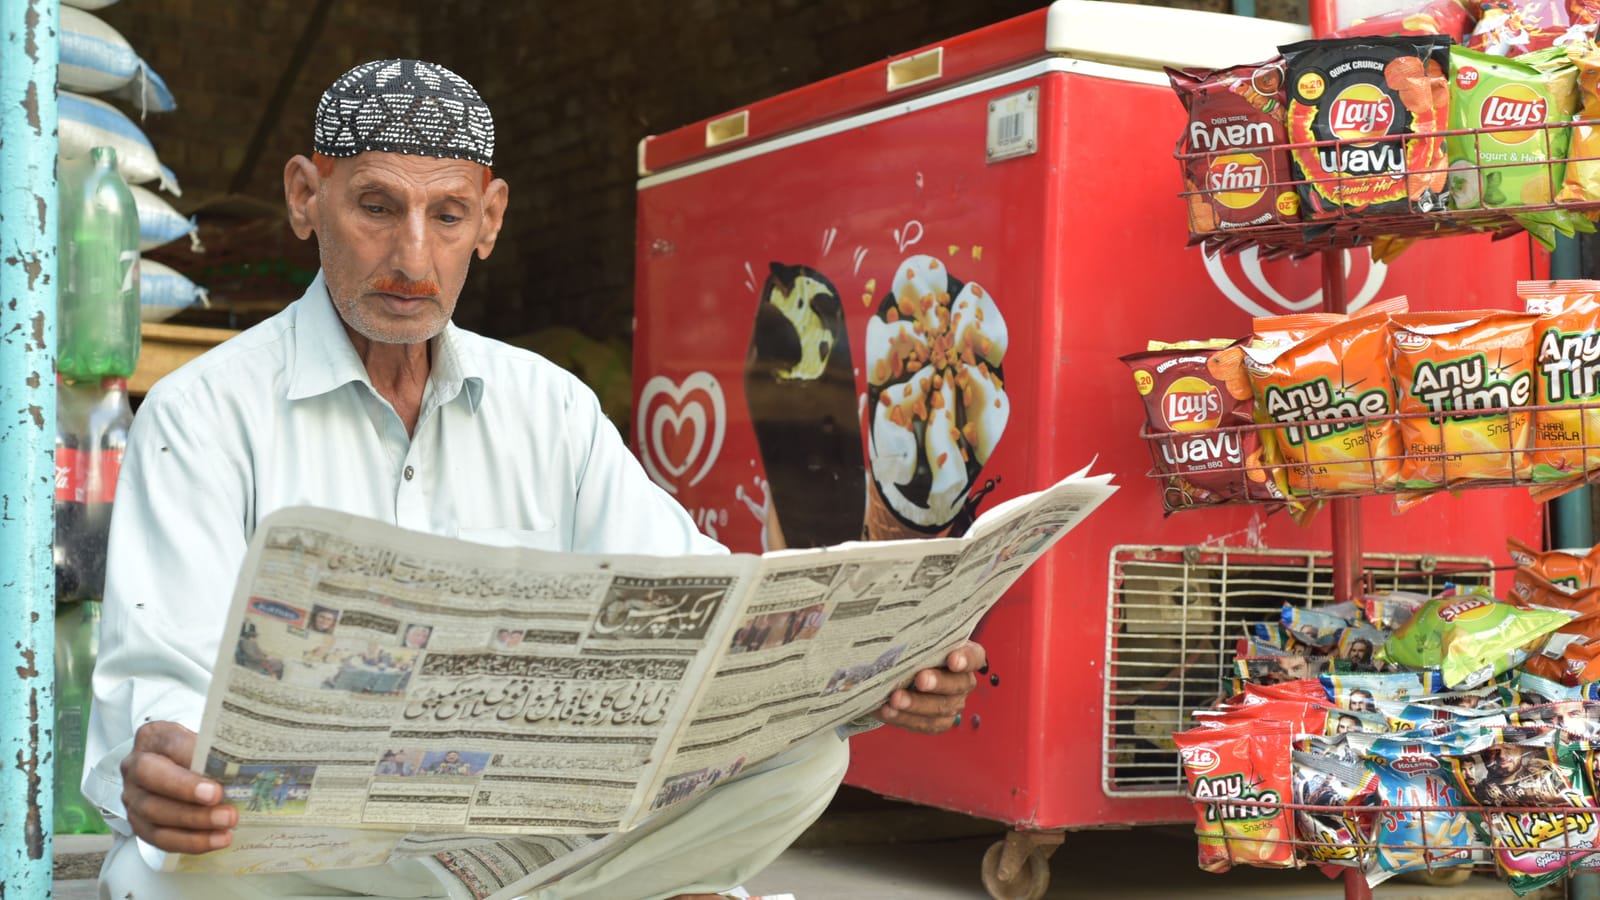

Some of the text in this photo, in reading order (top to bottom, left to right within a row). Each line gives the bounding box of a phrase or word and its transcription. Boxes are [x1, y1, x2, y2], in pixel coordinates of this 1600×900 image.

[1329, 60, 1384, 78] QUICK CRUNCH
[1334, 99, 1390, 133] Lay's
[1483, 97, 1544, 127] Lay's
[1190, 121, 1274, 151] wavy
[1319, 144, 1405, 180] wavy
[1210, 162, 1263, 195] Lay's
[1538, 332, 1600, 362] Any
[1413, 359, 1482, 393] Any
[1168, 390, 1218, 423] Lay's
[1267, 381, 1328, 415] Any
[1424, 376, 1530, 420] Time
[1277, 393, 1387, 443] Time
[1487, 416, 1526, 437] Snacks
[1162, 432, 1241, 464] wavy
[1343, 429, 1383, 450] Snacks
[1195, 776, 1241, 798] Any
[1206, 793, 1278, 820] Time
[1381, 776, 1459, 832] SLANT
[1243, 822, 1273, 833] Snacks
